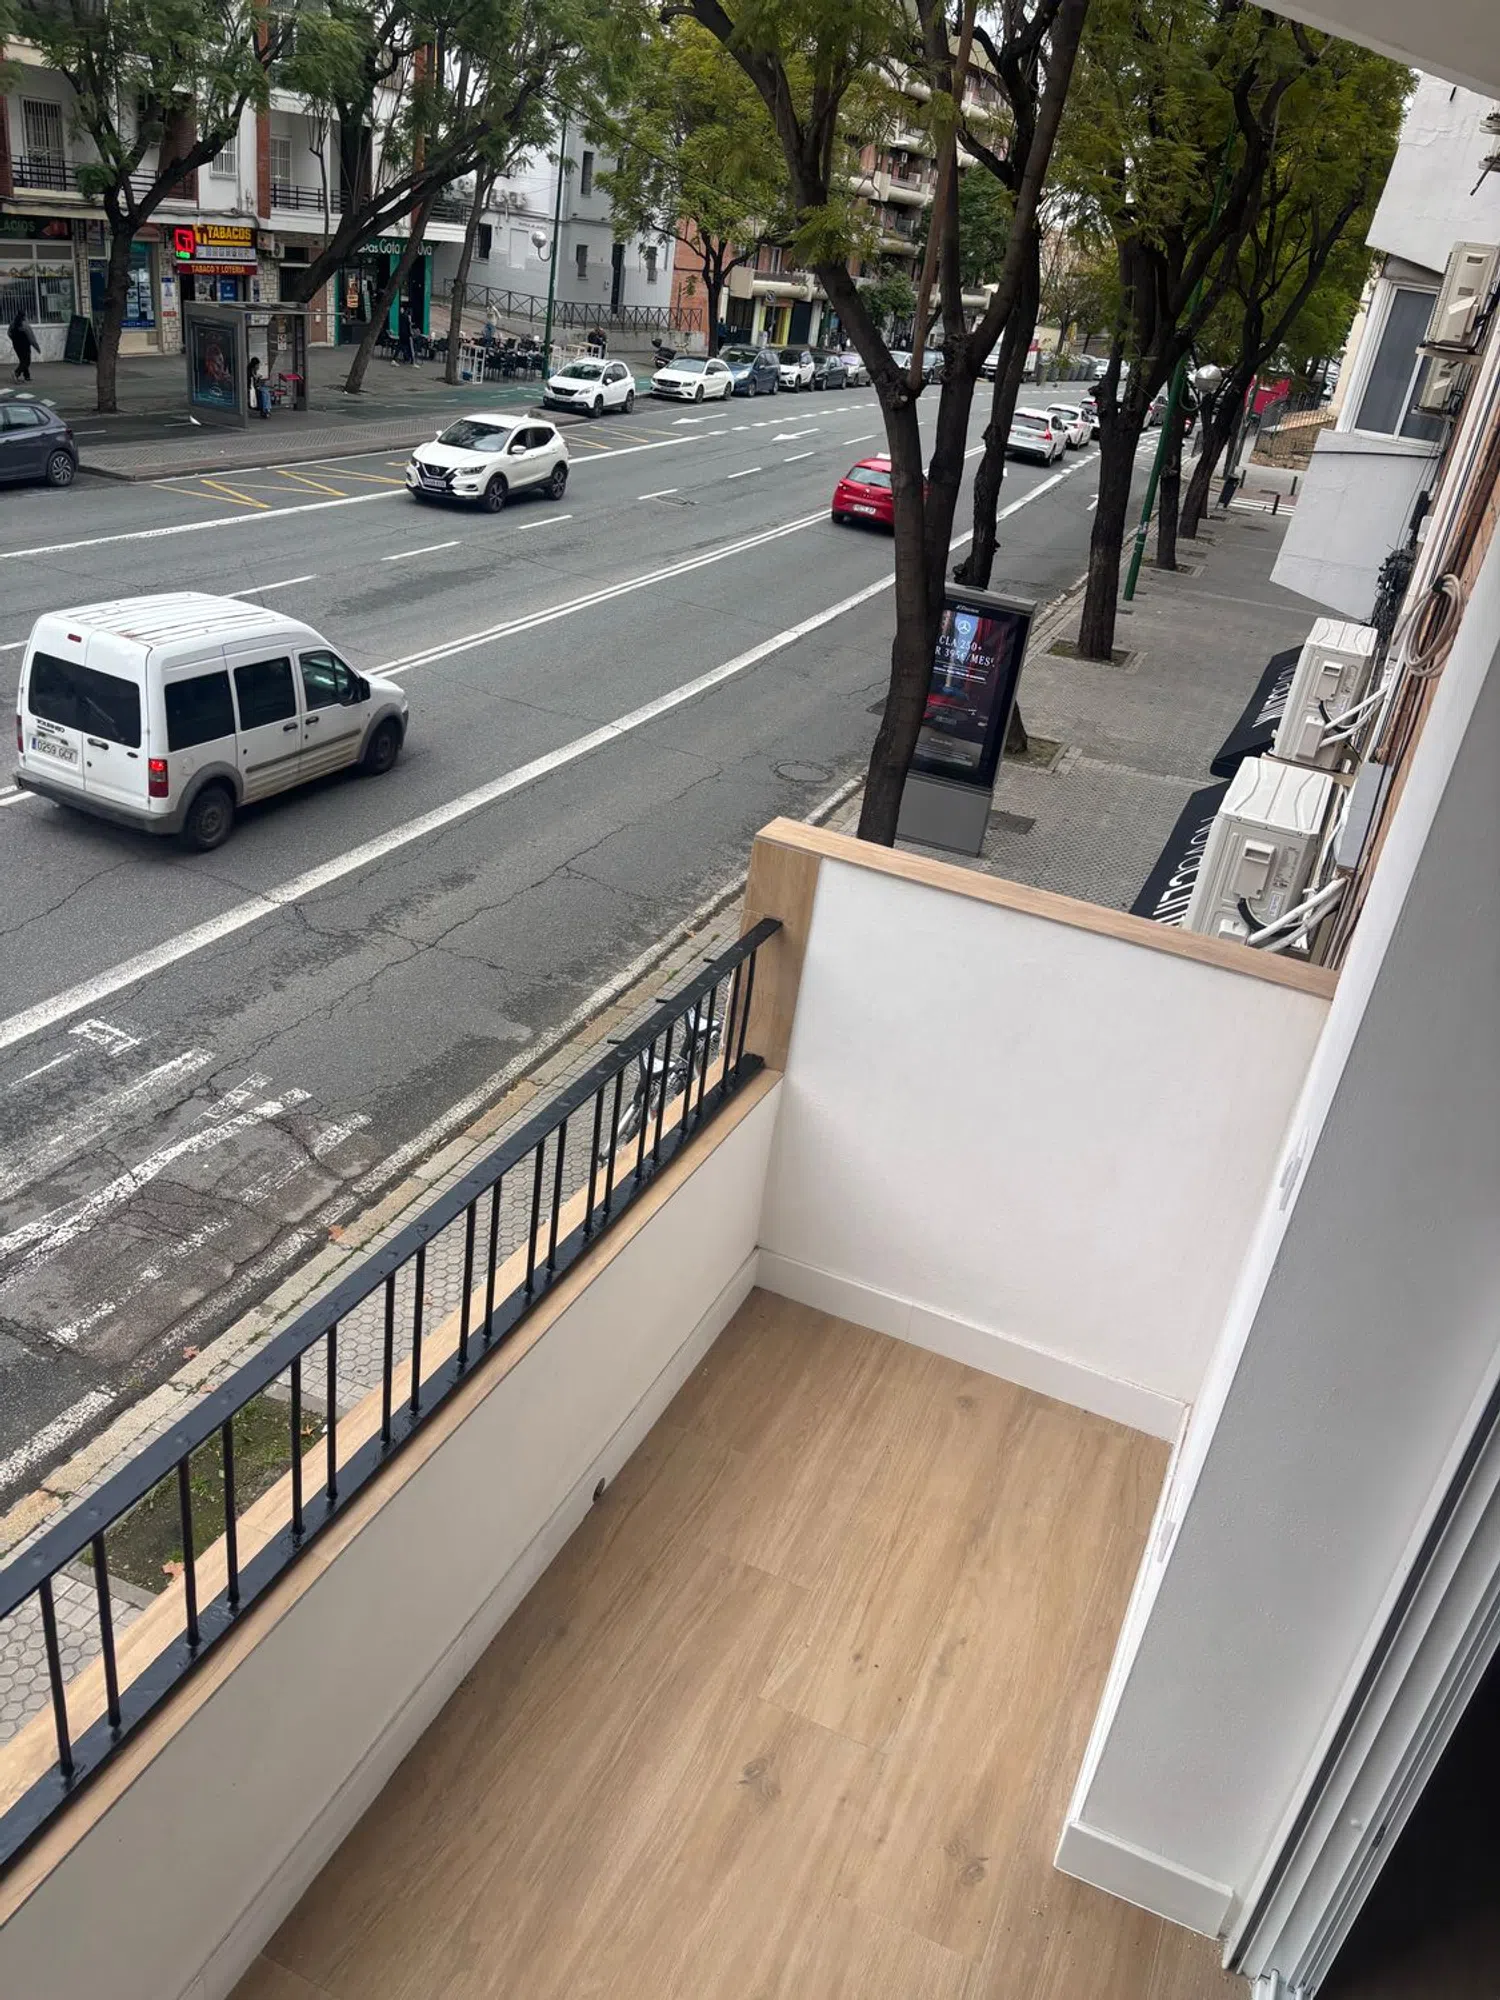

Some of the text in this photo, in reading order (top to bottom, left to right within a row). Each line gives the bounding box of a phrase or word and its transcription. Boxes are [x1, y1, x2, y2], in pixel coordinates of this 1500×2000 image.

[206, 226, 251, 241] TABACOS
[380, 238, 400, 254] Gota
[191, 265, 215, 274] TABACO
[215, 266, 220, 274] Y
[939, 634, 957, 648] CLA
